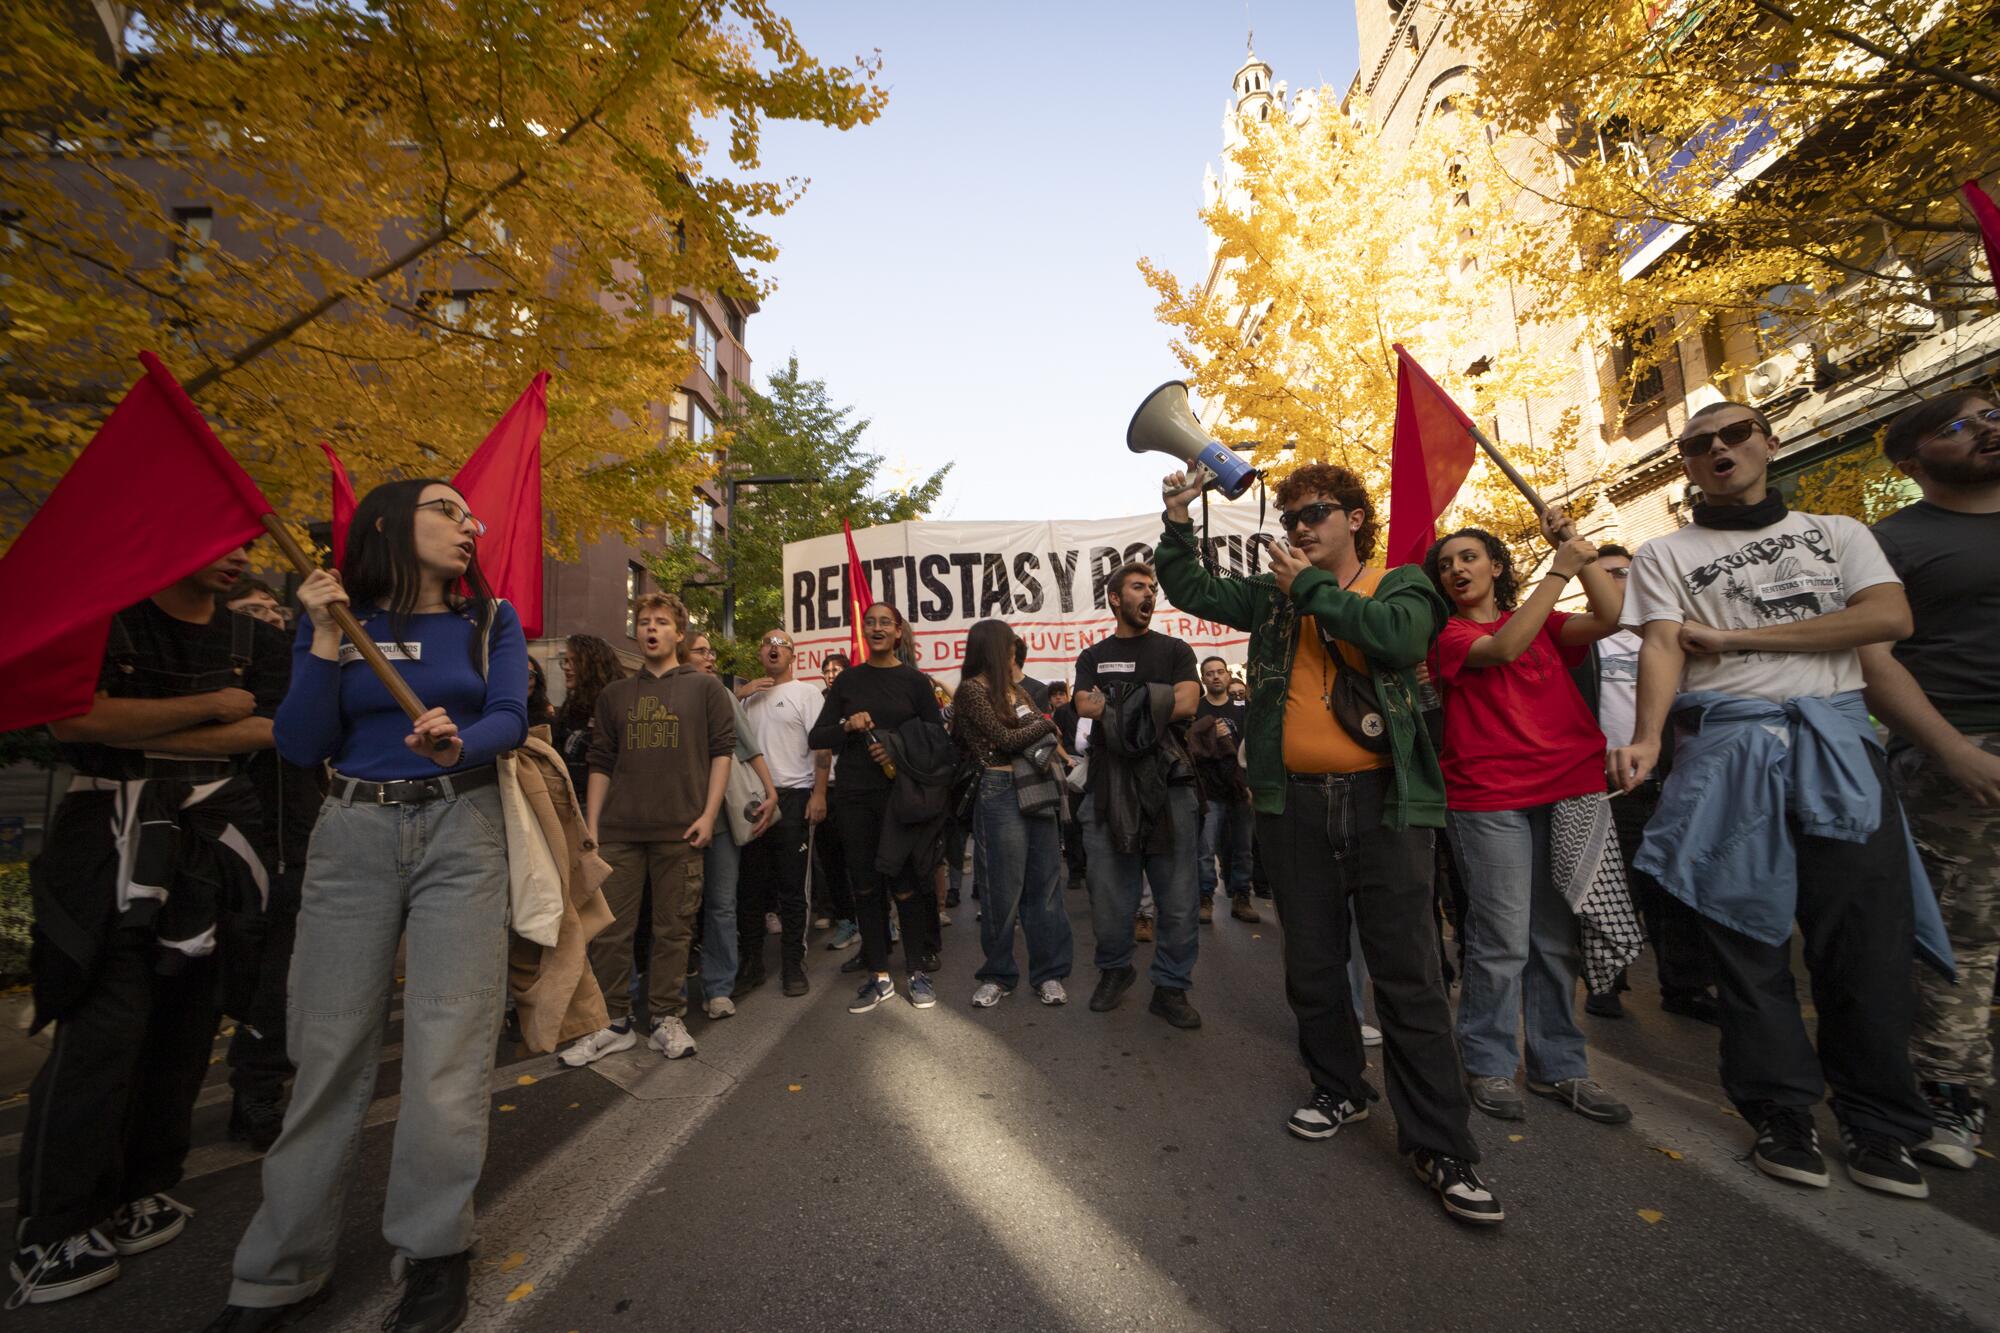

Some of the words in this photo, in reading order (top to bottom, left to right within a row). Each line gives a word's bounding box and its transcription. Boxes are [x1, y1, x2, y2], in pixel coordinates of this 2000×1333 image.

[1048, 550, 1079, 613] Y
[1761, 580, 1800, 594] RENTISTAS
[1806, 577, 1834, 588] PLÍTICOS
[934, 640, 968, 660] DE
[1022, 628, 1117, 651] UVENT
[627, 721, 678, 750] HIGH
